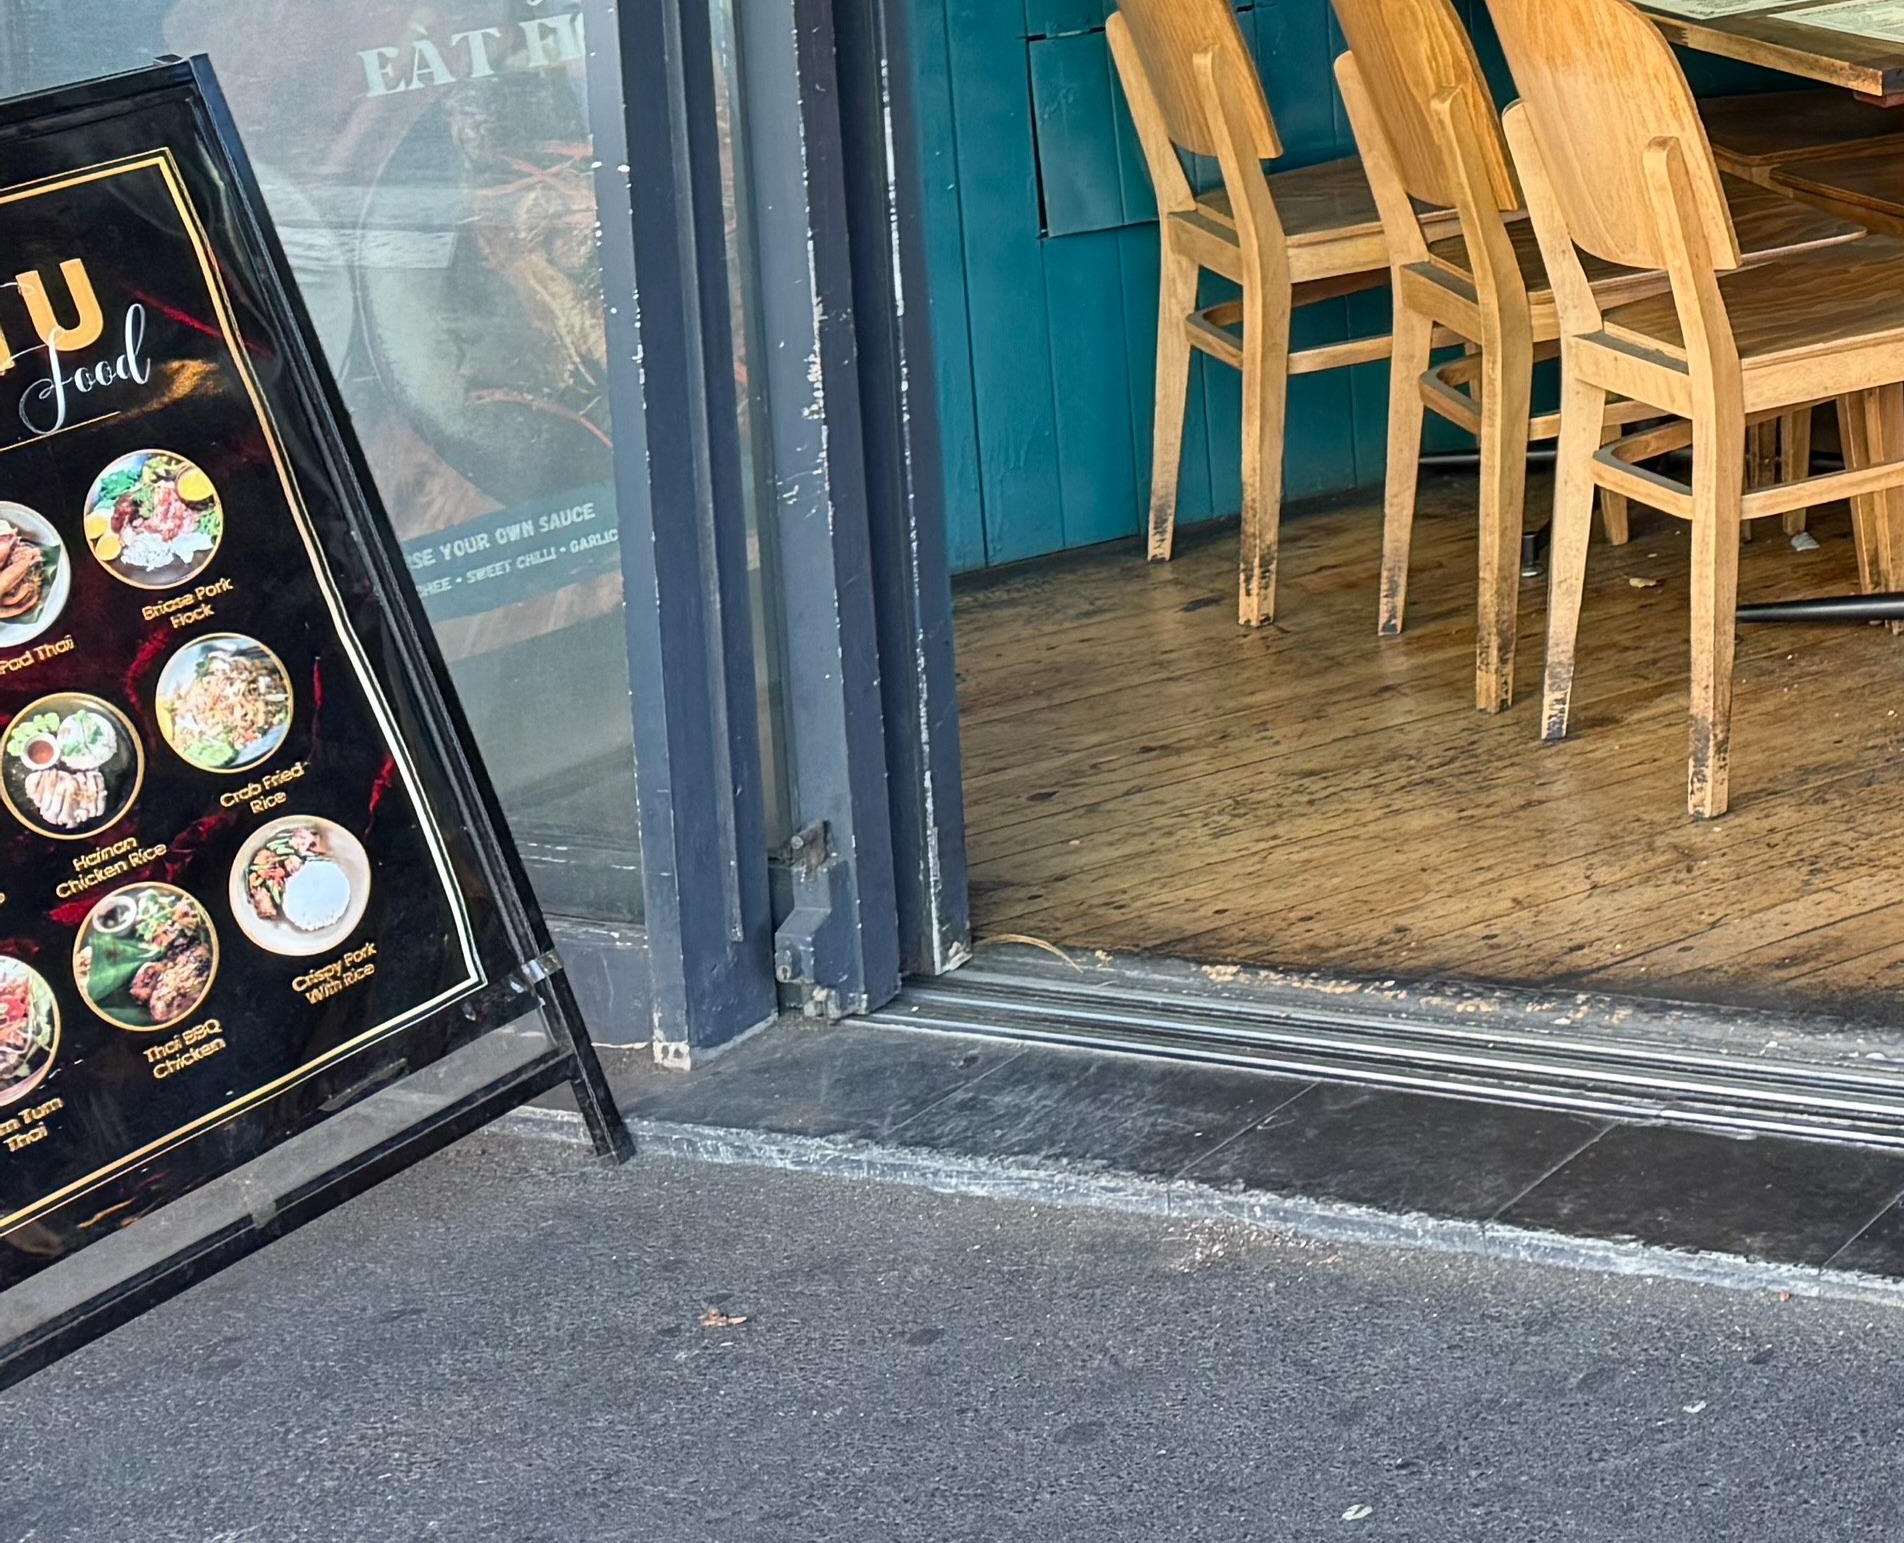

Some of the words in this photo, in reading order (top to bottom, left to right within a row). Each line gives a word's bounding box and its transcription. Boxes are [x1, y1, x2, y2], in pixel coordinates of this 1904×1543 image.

[18, 302, 151, 436] food
[439, 532, 491, 562] YOUR
[494, 519, 535, 546] OWN
[538, 502, 596, 533] SAUCE
[466, 558, 513, 585] SWEET
[516, 546, 557, 570] CHILLI
[569, 527, 619, 554] GARLIC
[195, 576, 234, 602] Pork
[169, 602, 216, 629] Hock
[0, 649, 35, 676] Pad
[33, 633, 75, 662] Thai
[219, 782, 262, 808] Crab
[261, 763, 307, 793] Fried
[249, 790, 288, 815] Rice
[55, 860, 129, 899] Chicken
[128, 842, 168, 867] Rice
[72, 835, 138, 873] Hainan
[291, 960, 343, 993] Crispy
[343, 941, 378, 968] Pork
[304, 977, 343, 1005] With
[342, 962, 376, 987] Rice
[143, 1034, 183, 1064] Thai
[182, 1018, 223, 1046] BBQ
[152, 1037, 227, 1080] Chicken
[17, 1096, 65, 1125] Tum
[2, 1120, 49, 1153] Thai
